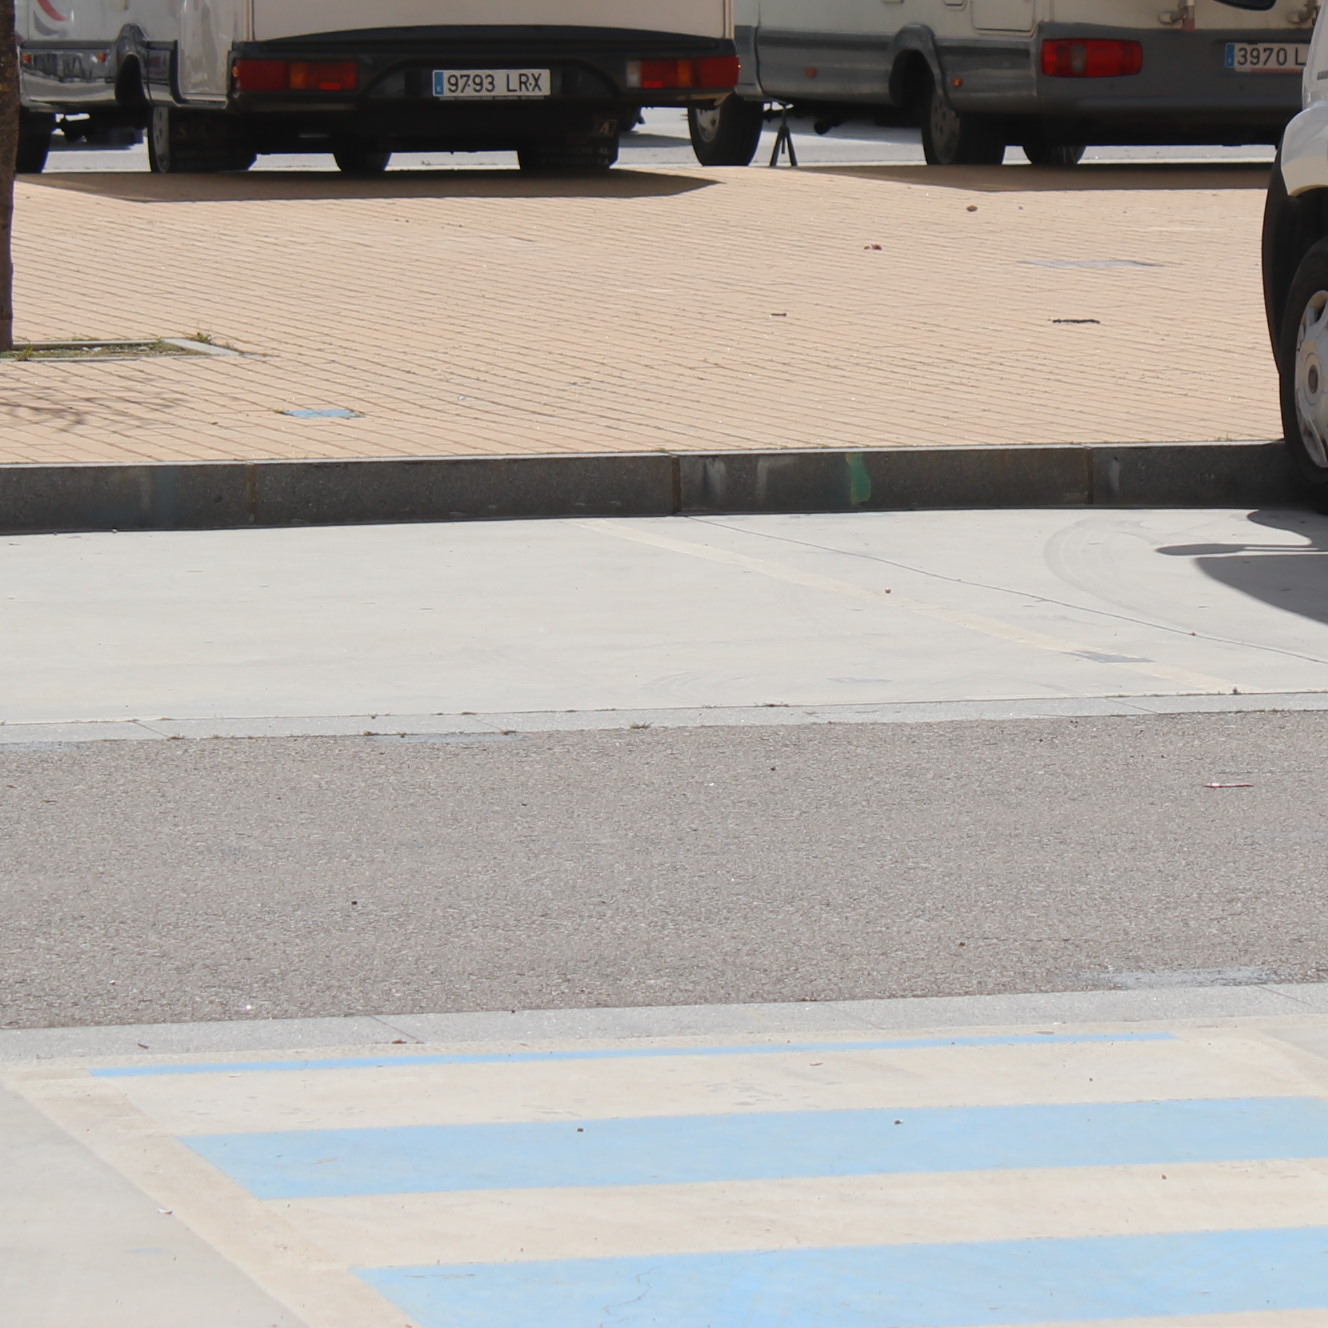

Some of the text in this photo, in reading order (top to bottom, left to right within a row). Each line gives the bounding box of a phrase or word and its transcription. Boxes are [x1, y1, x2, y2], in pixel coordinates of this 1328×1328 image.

[1236, 47, 1288, 66] 3970
[447, 73, 543, 93] 9793 LRX
